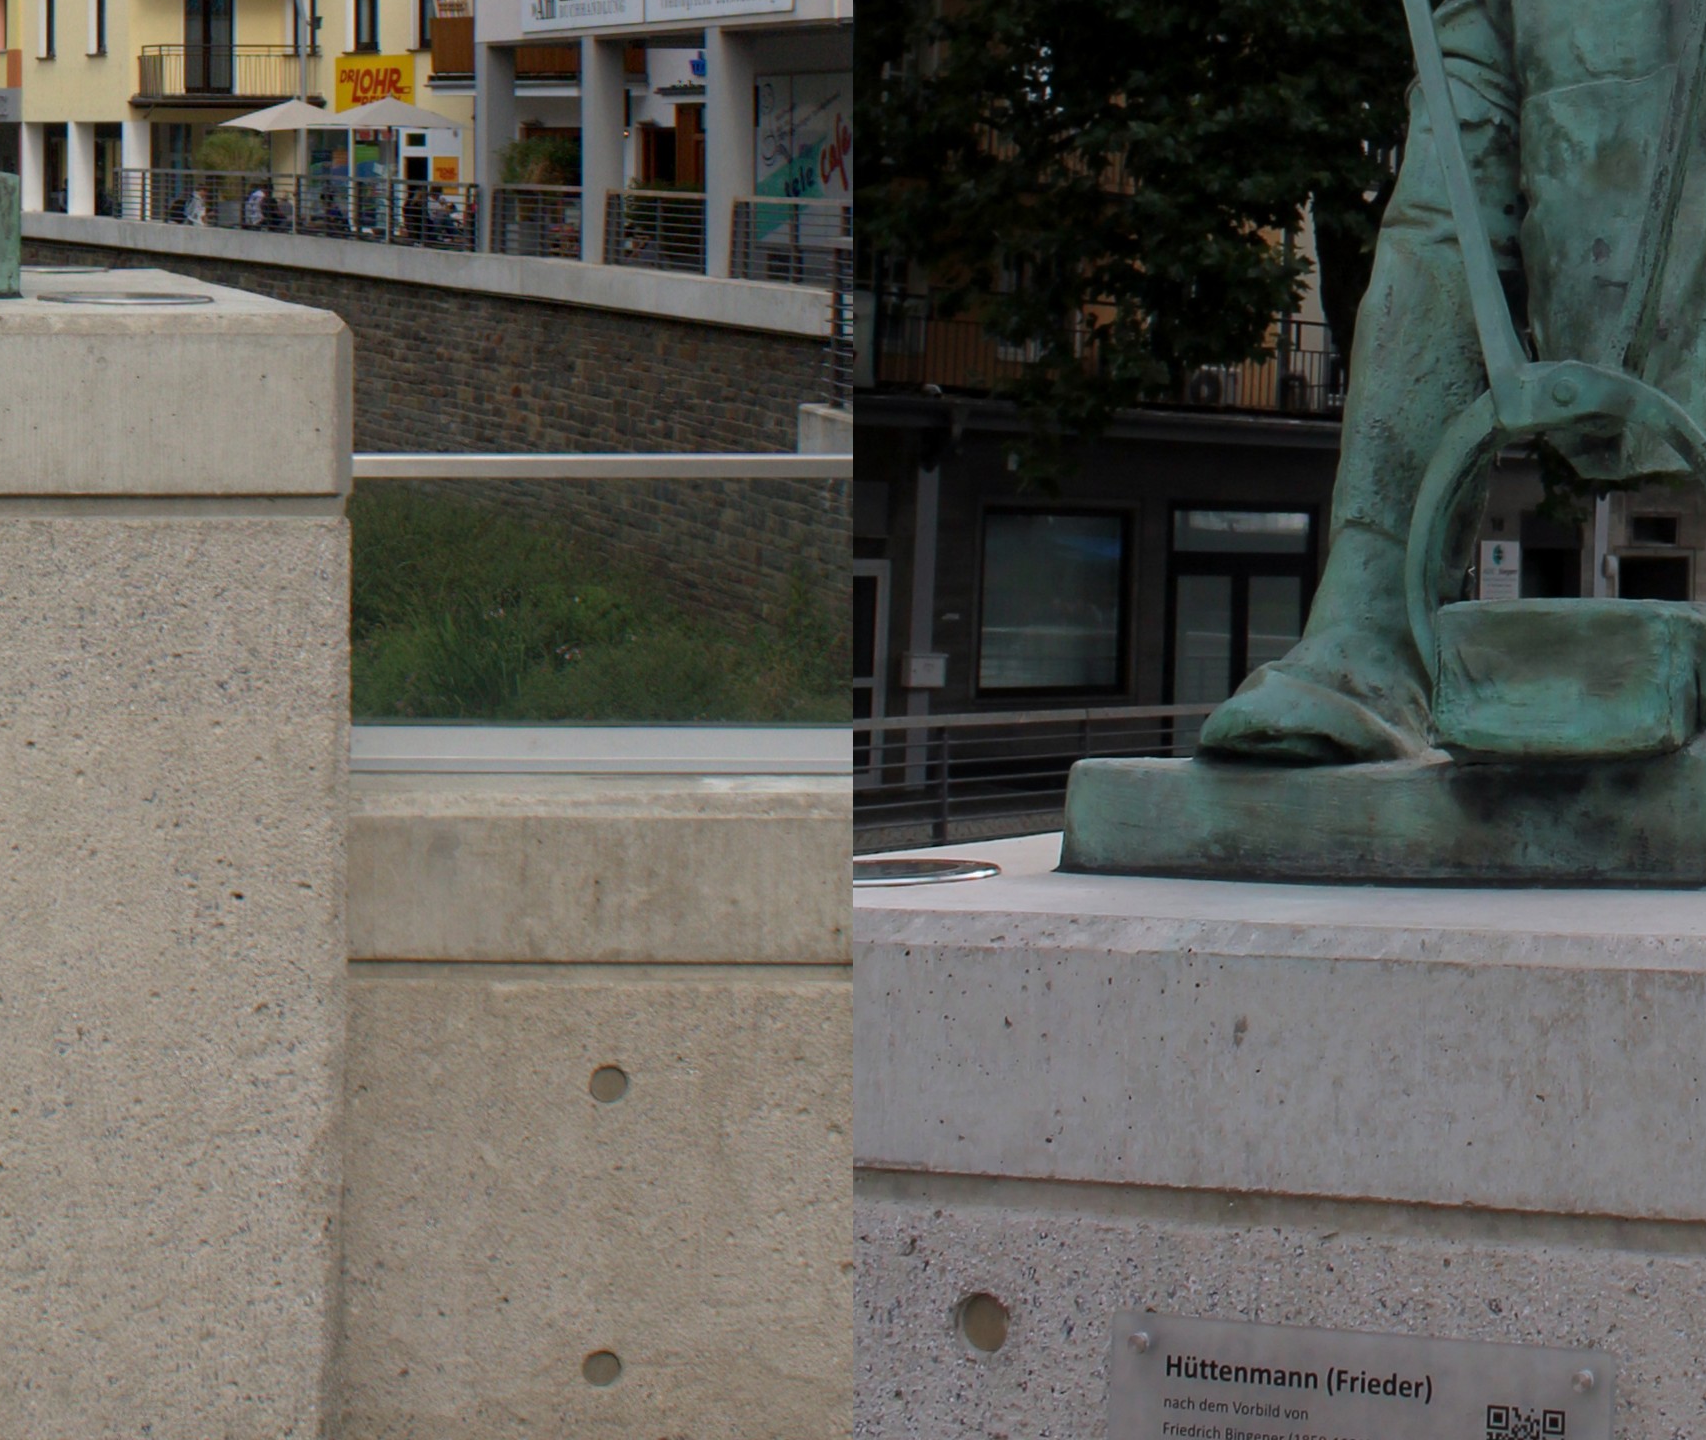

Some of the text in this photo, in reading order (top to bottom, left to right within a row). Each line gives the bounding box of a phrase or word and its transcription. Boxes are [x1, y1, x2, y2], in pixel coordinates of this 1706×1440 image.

[559, 0, 626, 19] BUCHHANDLUNG
[352, 68, 403, 103] LOHR
[1166, 1355, 1432, 1405] Hüttenmann (Frieder)
[1164, 1397, 1309, 1420] nach dem Vorbild von
[1163, 1422, 1221, 1440] Friedrich
